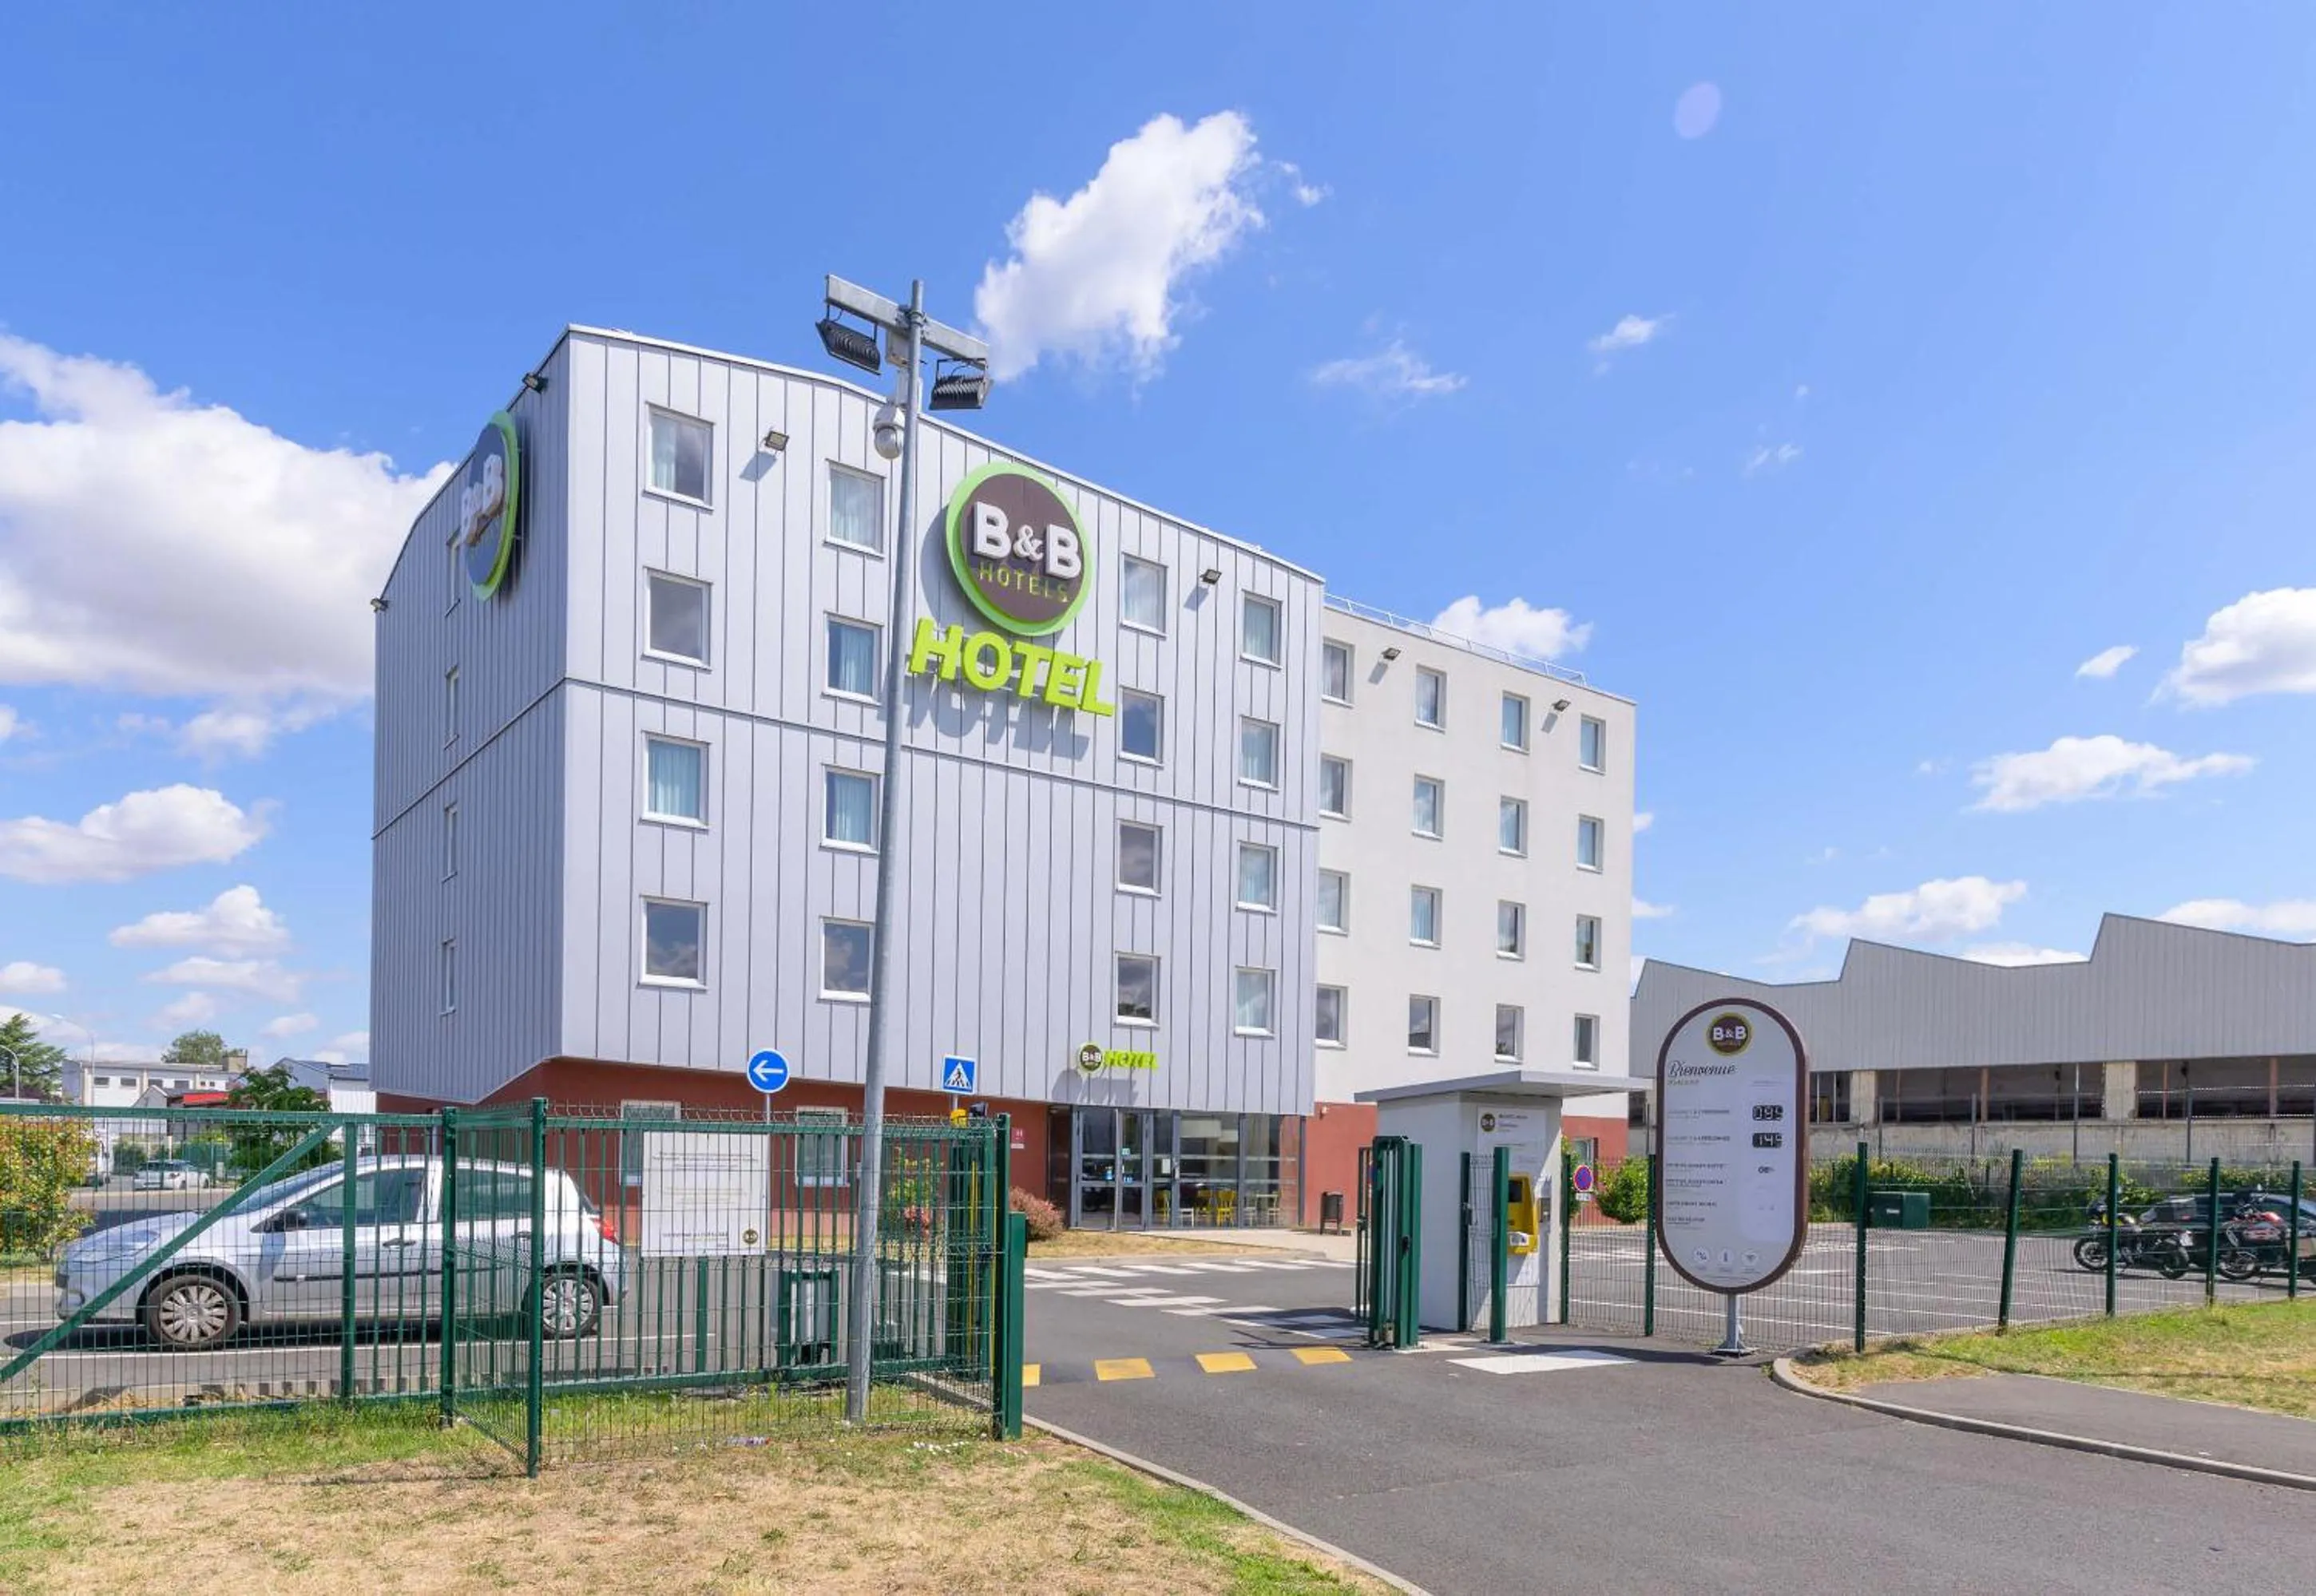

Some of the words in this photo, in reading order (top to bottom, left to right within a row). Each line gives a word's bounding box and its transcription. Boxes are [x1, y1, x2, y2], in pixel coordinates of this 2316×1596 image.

[973, 501, 1082, 580] B&B
[978, 561, 1069, 603] HOTELS
[908, 617, 1114, 717] HOTEL
[1712, 1025, 1747, 1041] B&B
